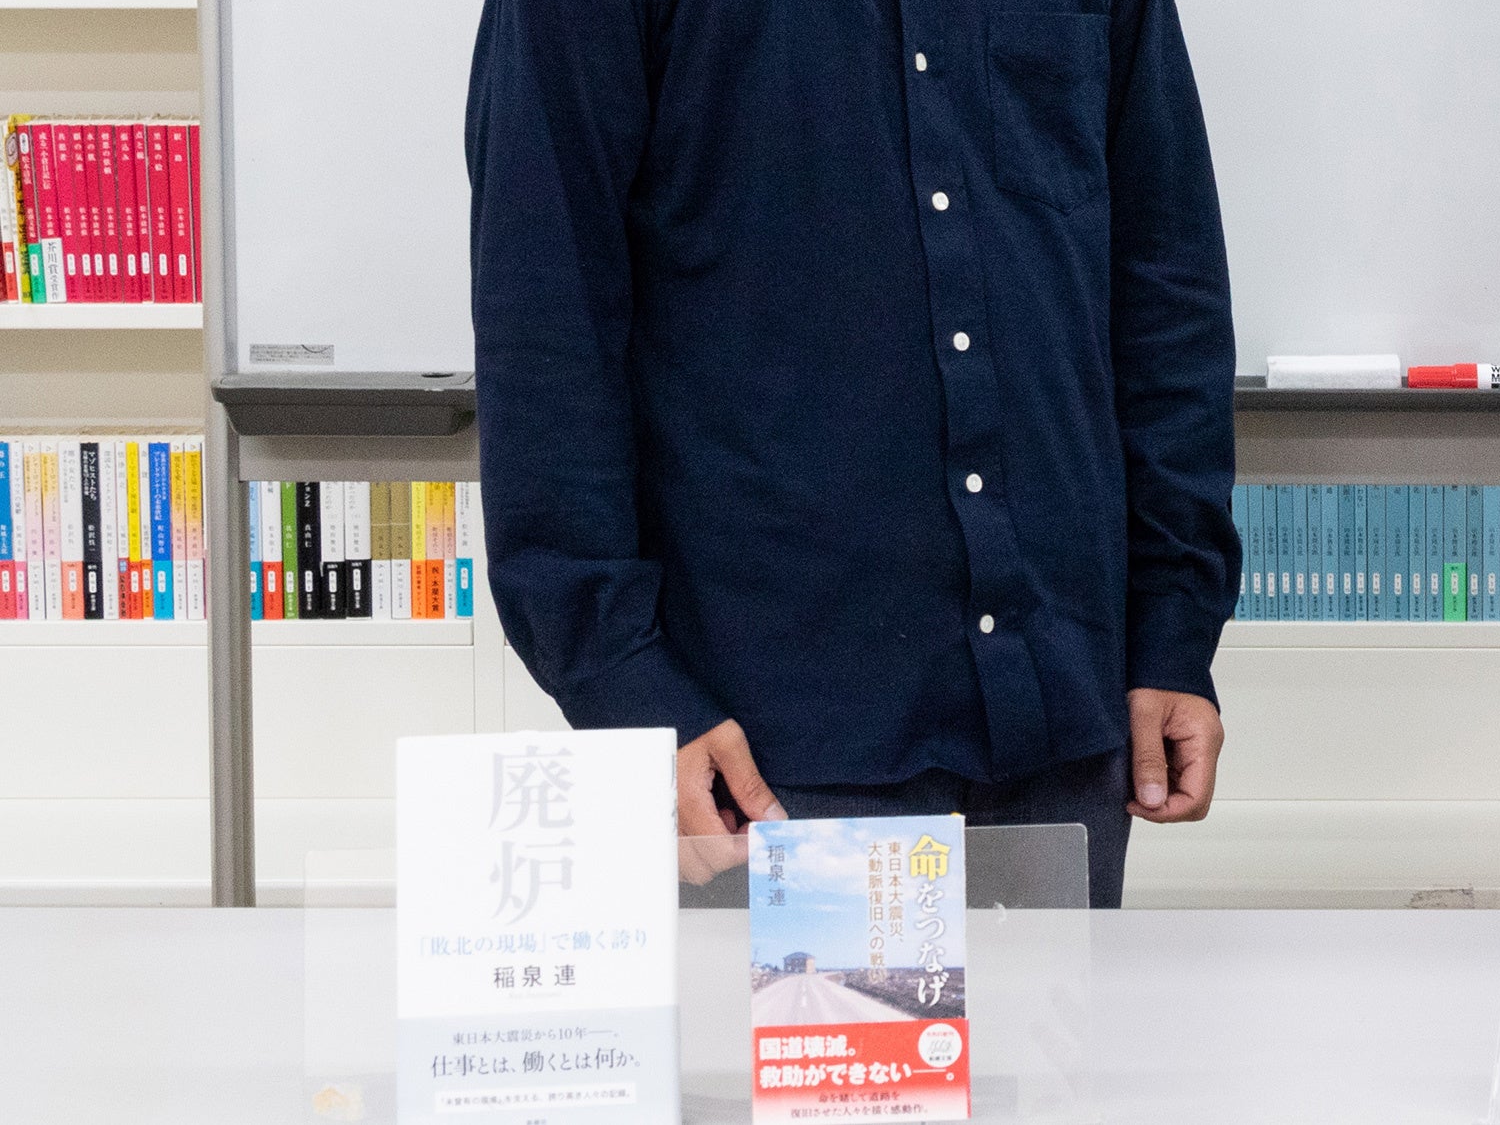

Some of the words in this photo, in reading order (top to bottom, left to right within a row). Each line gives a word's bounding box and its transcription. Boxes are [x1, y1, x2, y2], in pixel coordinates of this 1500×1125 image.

[487, 744, 576, 926] 廃炉
[908, 833, 951, 1008] 命をつなげ
[419, 928, 648, 958] 「敗北の現場」で働く誇り
[431, 1046, 642, 1078] 仕事とは、働くとは何か。
[758, 1034, 856, 1061] 国道壊滅。
